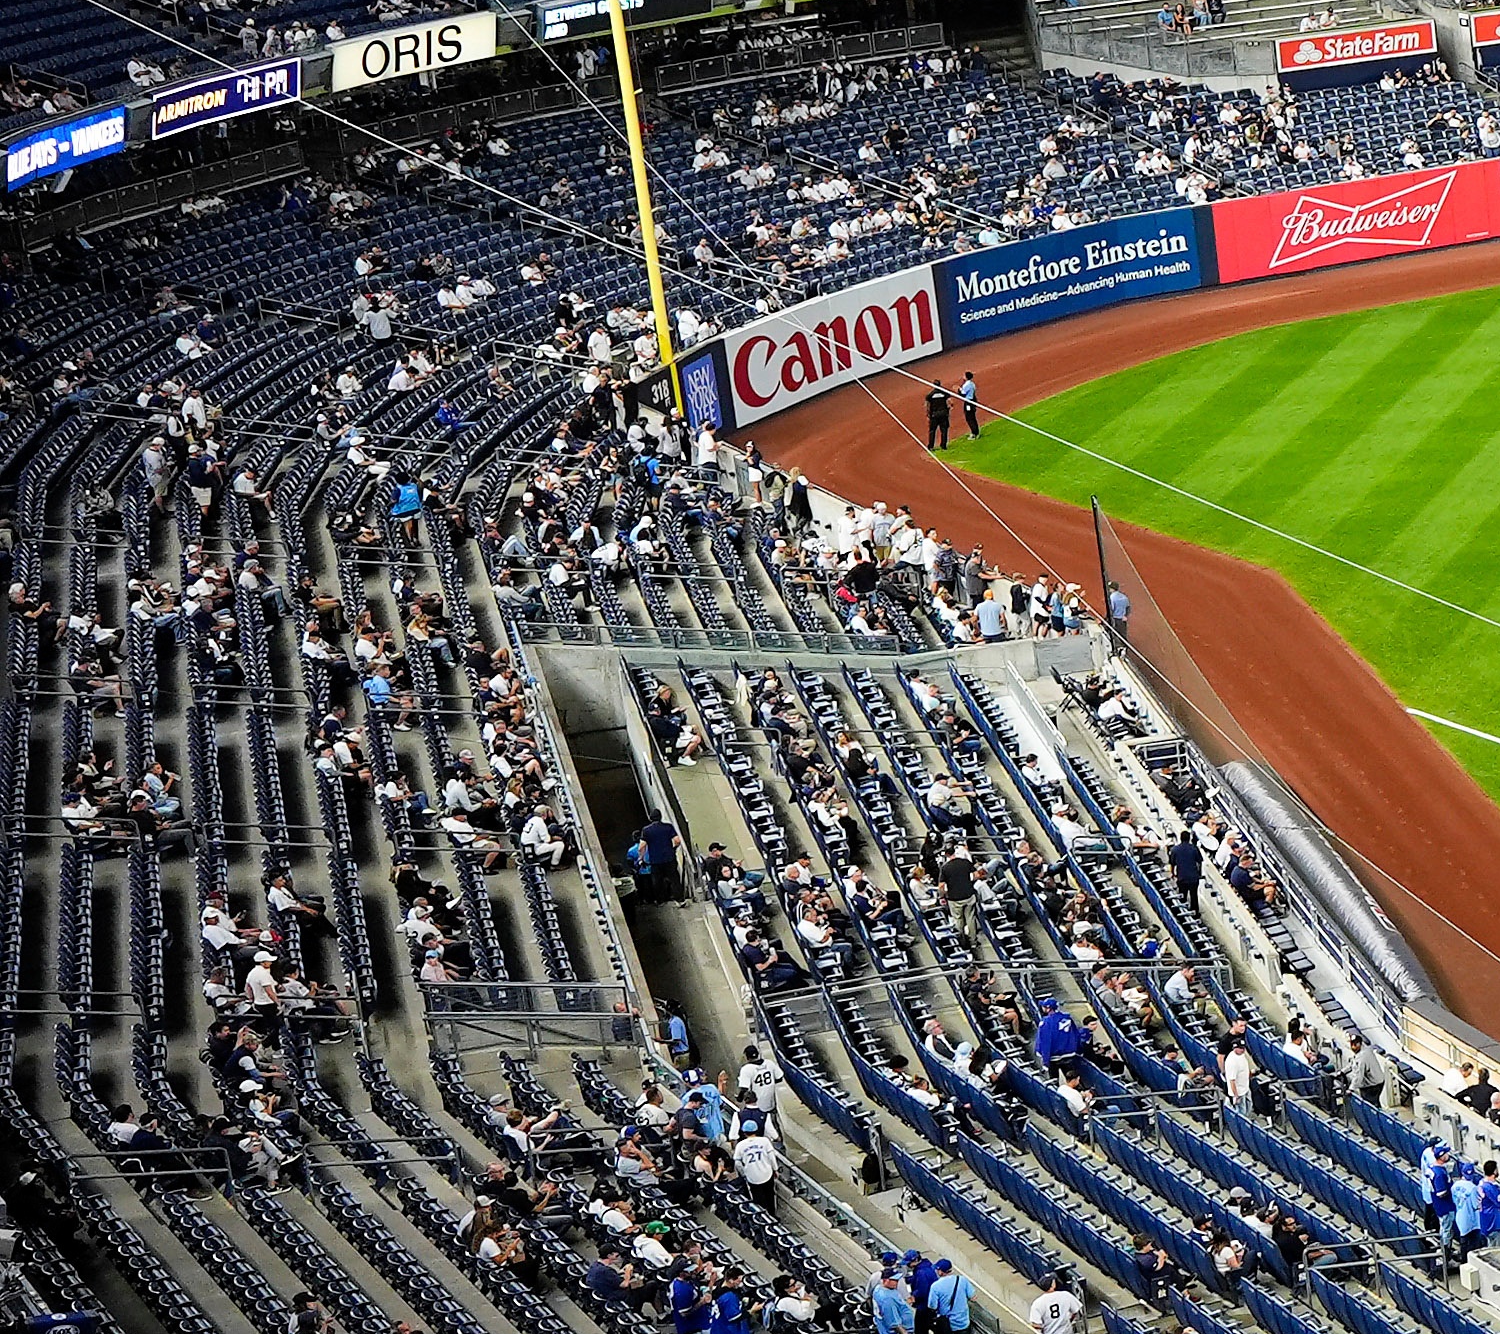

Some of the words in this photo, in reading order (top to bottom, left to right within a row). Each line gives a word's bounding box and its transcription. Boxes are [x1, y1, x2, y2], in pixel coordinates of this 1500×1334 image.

[362, 25, 462, 77] ORIS
[158, 90, 227, 124] ARMITRON
[1283, 201, 1438, 247] Budweiser
[956, 255, 1081, 303] Montefiore
[1084, 230, 1188, 270] Einstein
[733, 289, 935, 407] Canon
[652, 379, 669, 404] 318
[755, 1071, 771, 1086] 48
[1050, 1303, 1060, 1318] 8
